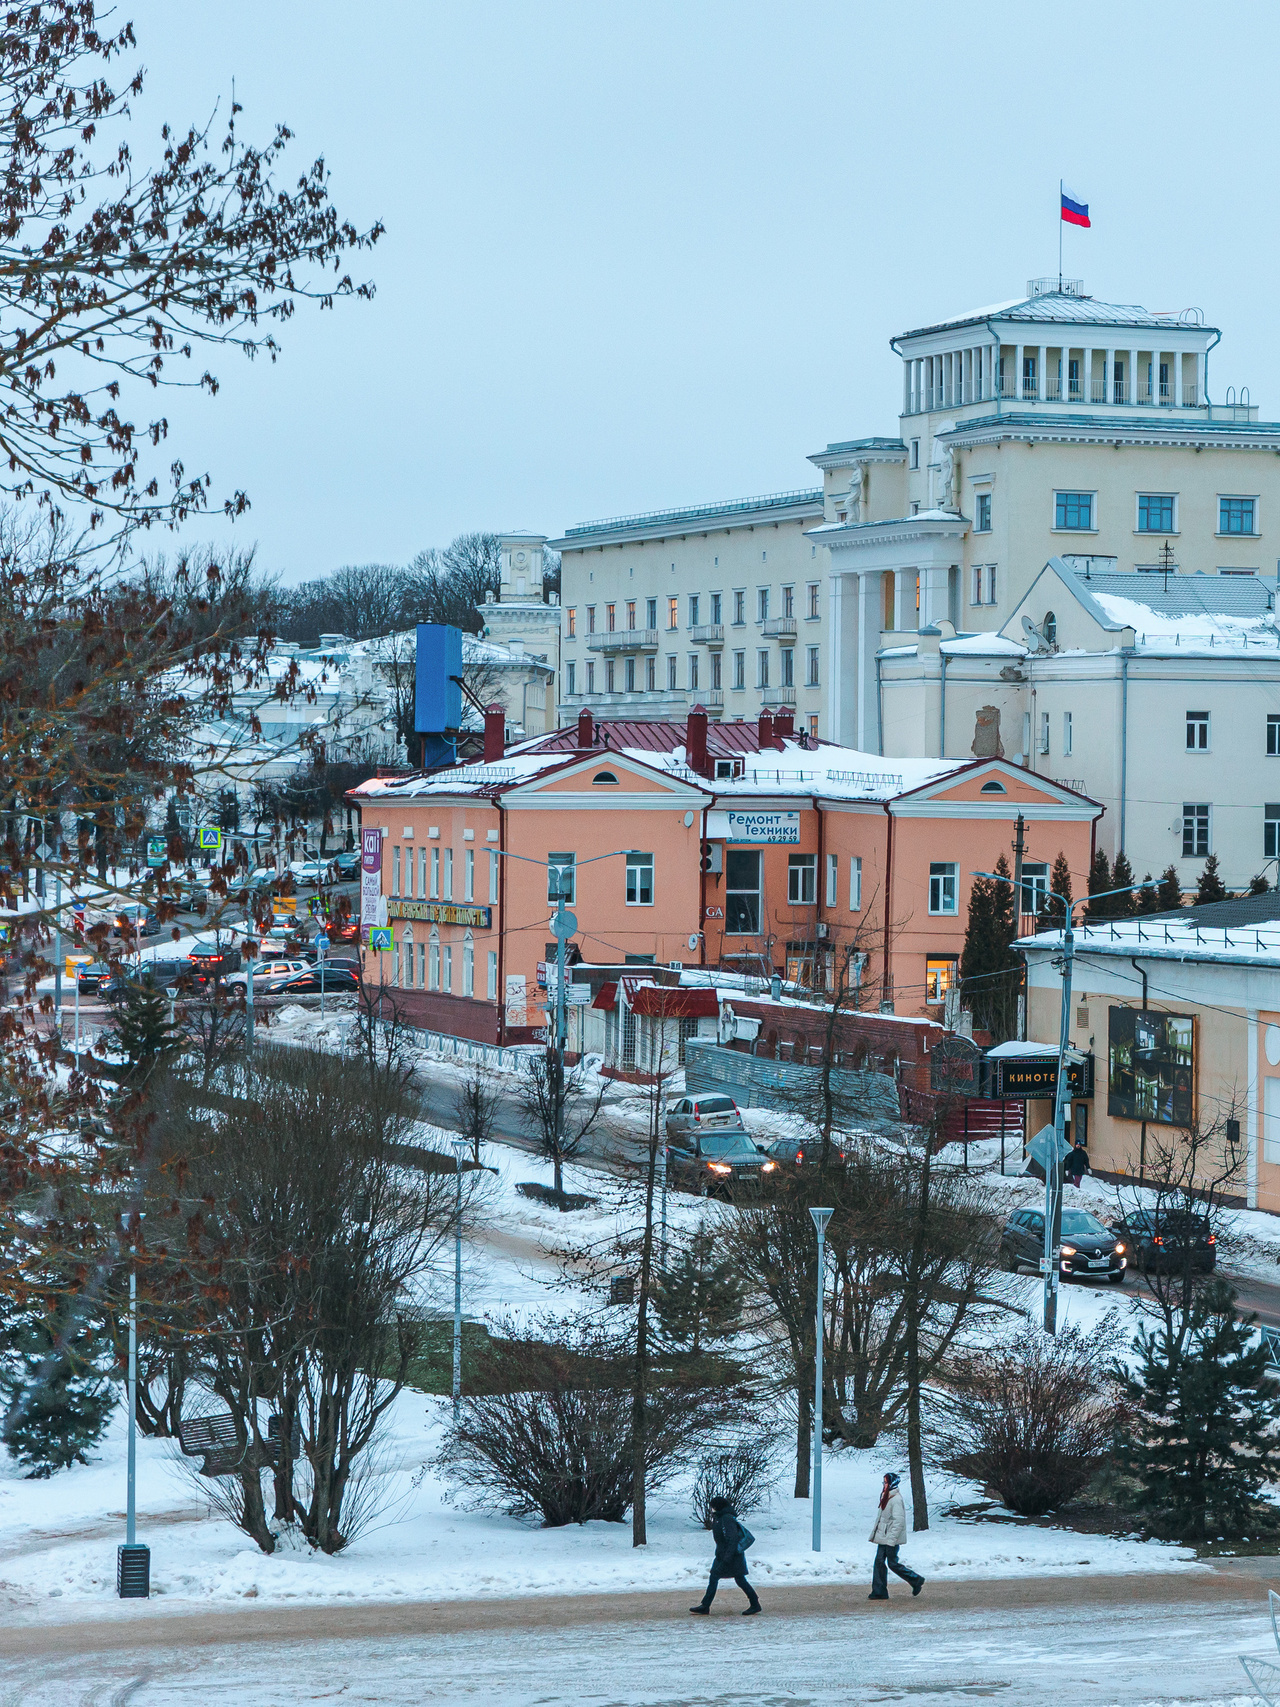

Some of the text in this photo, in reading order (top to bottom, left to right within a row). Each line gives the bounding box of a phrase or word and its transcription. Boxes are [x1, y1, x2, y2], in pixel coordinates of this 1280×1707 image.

[729, 813, 781, 825] Ремонт
[745, 824, 798, 835] Техники
[1009, 1073, 1077, 1082] КИНОТЕР
